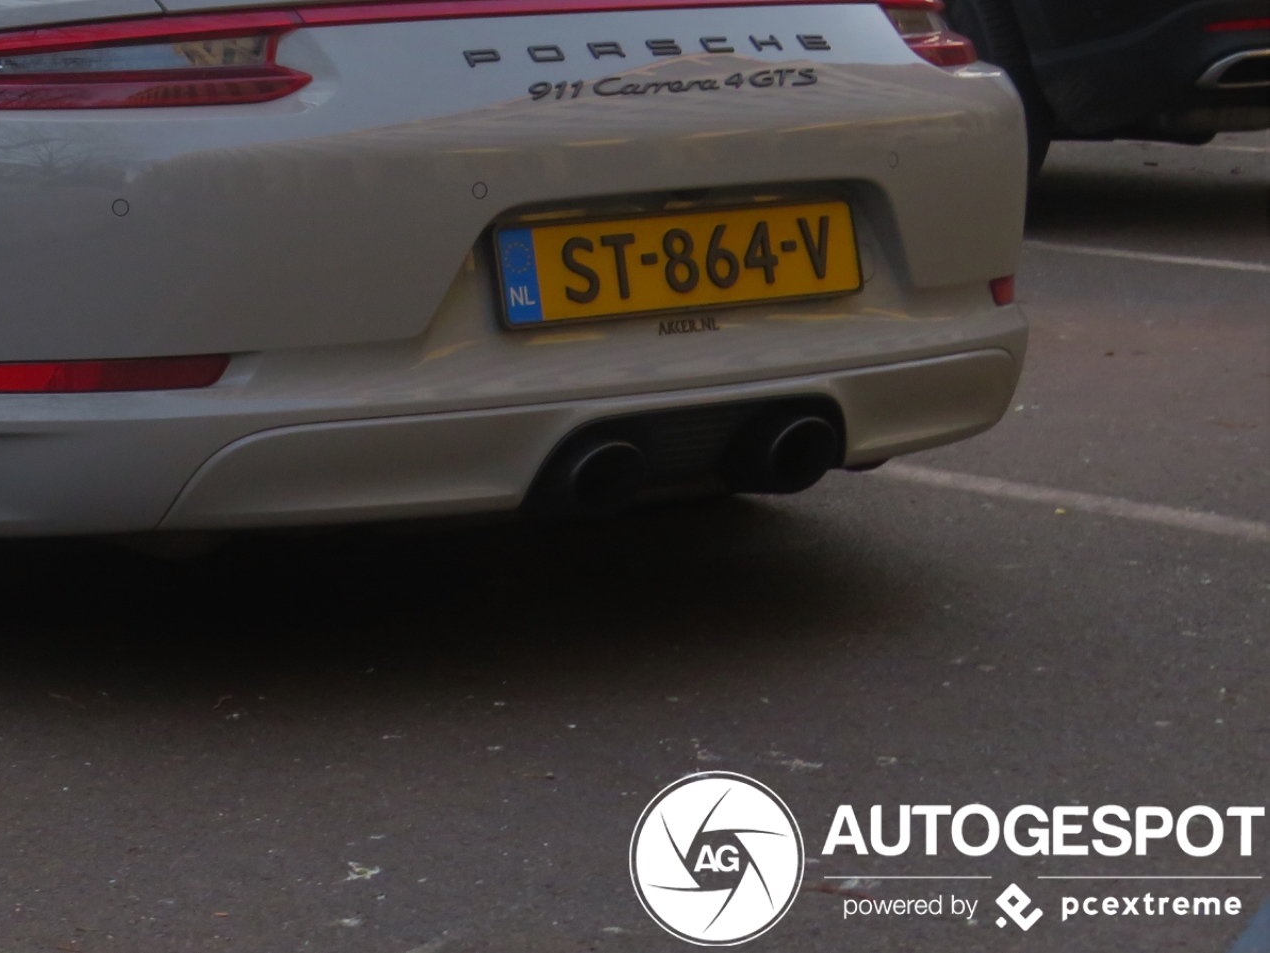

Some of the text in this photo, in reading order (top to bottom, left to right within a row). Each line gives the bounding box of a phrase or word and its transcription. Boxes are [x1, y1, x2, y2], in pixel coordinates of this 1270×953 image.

[463, 34, 831, 67] PORSCHE
[528, 67, 818, 100] 911 Carrera 4 GTS
[560, 214, 830, 305] ST-864-V
[509, 285, 536, 308] NL
